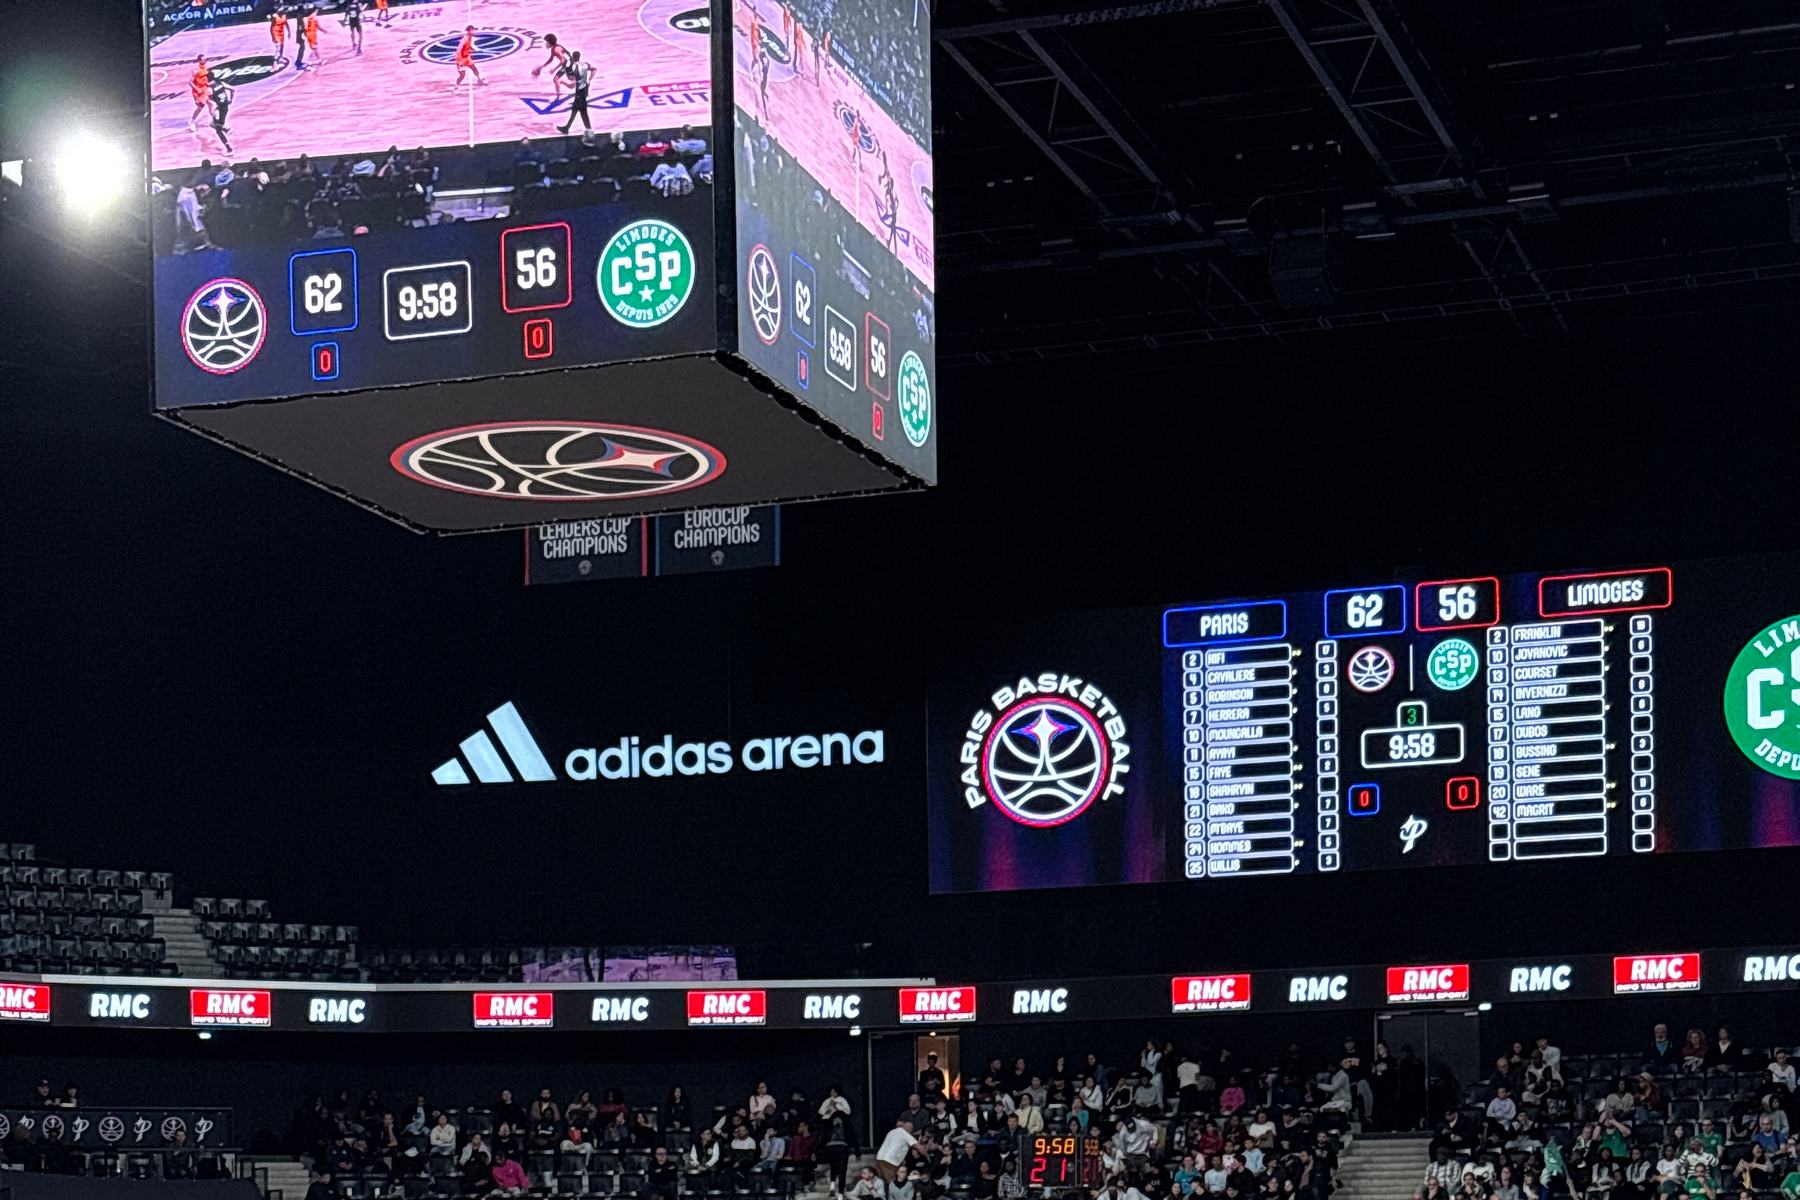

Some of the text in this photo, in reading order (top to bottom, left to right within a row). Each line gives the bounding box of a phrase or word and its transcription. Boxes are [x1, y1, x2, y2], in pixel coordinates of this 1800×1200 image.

[216, 4, 252, 16] ARENA
[616, 226, 676, 252] LIMOGES
[516, 247, 556, 289] 56
[612, 242, 681, 296] CSP
[304, 273, 342, 314] 62
[400, 282, 457, 321] 9:58
[796, 280, 811, 326] 62
[616, 300, 654, 320] DEPUIS
[532, 326, 544, 349] 0
[830, 327, 852, 372] 9:58
[870, 336, 886, 378] 56
[320, 350, 332, 373] 0
[902, 370, 927, 421] CSP
[603, 517, 631, 535] CUP
[684, 505, 750, 528] EUROCUP
[543, 534, 628, 559] CHAMPIONS
[674, 524, 760, 549] CHAMPIONS
[1438, 586, 1476, 621] 56
[1567, 580, 1644, 607] LIMOGES
[1347, 594, 1383, 628] 62
[1200, 612, 1249, 637] PARIS
[1494, 626, 1562, 643] 2 FRANKLIN
[1190, 654, 1196, 666] 2
[1434, 650, 1472, 676] CSP
[1492, 645, 1568, 662] 10 JOVANOVIC
[1190, 674, 1197, 686] 4
[1208, 668, 1256, 684] CAVALIERE
[1492, 666, 1558, 682] 13 COURSET
[1190, 688, 1254, 704] 5 ROBINSON
[1493, 684, 1567, 702] 14 INVERNIZZI
[1190, 712, 1197, 724] 7
[1208, 708, 1250, 722] HERRERA
[1406, 708, 1417, 724] 3
[1493, 706, 1541, 720] 15 LANG
[991, 673, 1130, 801] BASKETBALL
[1189, 730, 1199, 742] 10
[1493, 724, 1548, 740] 17 DUBOS
[565, 730, 884, 782] adidas arena
[1190, 748, 1198, 761] 11
[1389, 733, 1435, 760] 9:58
[1516, 744, 1557, 758] BUSSING
[960, 710, 992, 809] PARIS
[1189, 768, 1200, 780] 15
[1209, 766, 1232, 779] FAYE
[1494, 764, 1540, 780] 19 SENE
[1359, 790, 1370, 807] 0
[1458, 784, 1468, 800] 0
[1492, 787, 1506, 799] 20
[1516, 784, 1545, 798] WARE
[1189, 805, 1200, 818] 21
[1210, 803, 1235, 816] BAKO
[1493, 803, 1554, 818] 42 MAGRIT
[1189, 824, 1201, 837] 22
[1210, 840, 1251, 854] HOMMES
[1210, 859, 1241, 872] WILLIS
[1402, 969, 1454, 990] RMC
[1510, 965, 1572, 992] RMC
[1631, 958, 1684, 980] RMC
[1744, 956, 1800, 982] RMC
[1188, 978, 1236, 1000] RMC
[1288, 976, 1348, 1002] RMC
[90, 994, 150, 1018] RMC
[206, 994, 256, 1014] RMC
[309, 998, 366, 1024] RMC
[490, 997, 538, 1016] RMC
[591, 998, 649, 1022] RMC
[703, 994, 750, 1014] RMC
[804, 996, 860, 1019] RMC
[914, 992, 961, 1012] RMC
[1012, 988, 1068, 1014] RMC
[1035, 1138, 1075, 1155] 9:58
[1030, 1158, 1067, 1183] 21
[1083, 1158, 1096, 1183] 21
